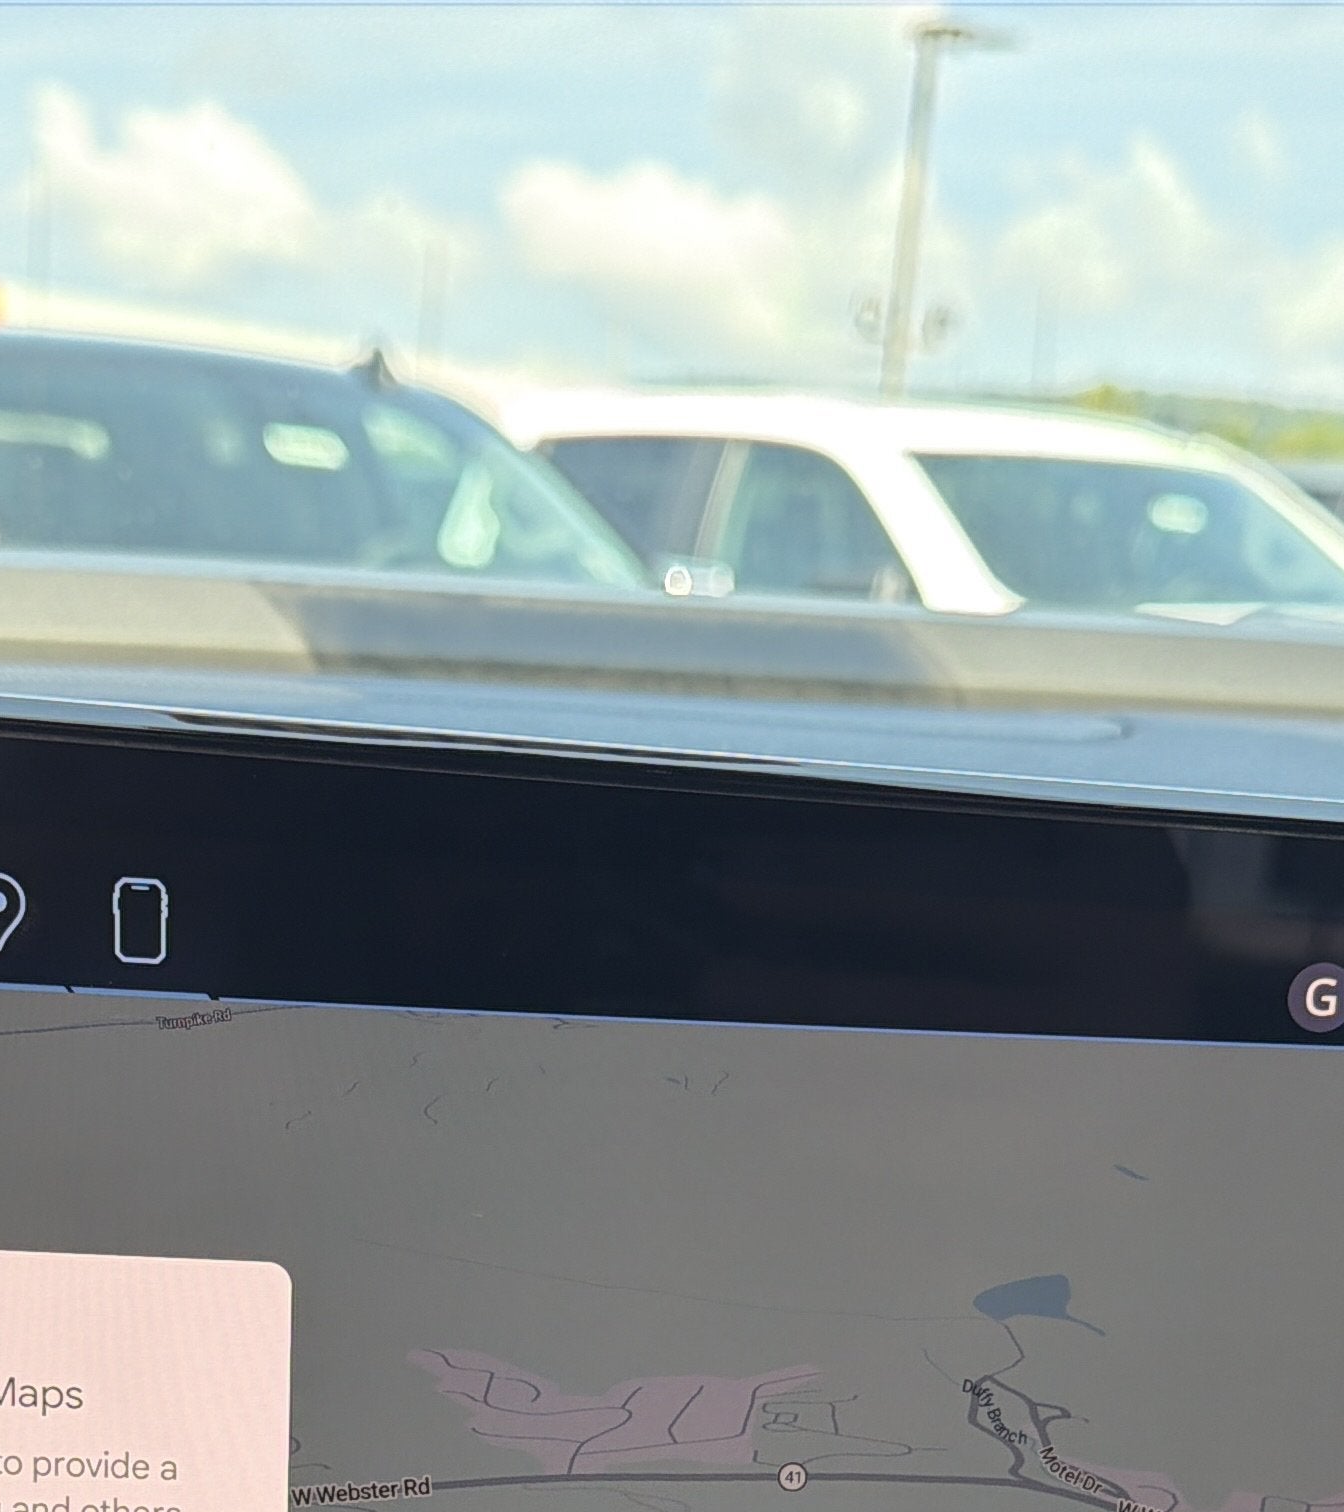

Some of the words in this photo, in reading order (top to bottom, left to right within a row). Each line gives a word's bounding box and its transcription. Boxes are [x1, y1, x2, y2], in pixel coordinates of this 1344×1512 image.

[1306, 979, 1336, 1016] G
[156, 1014, 212, 1031] Turnpike
[213, 1009, 232, 1024] Rd
[962, 1379, 994, 1407] Duffy
[987, 1408, 1027, 1444] Branch
[34, 1451, 149, 1483] provide
[161, 1461, 176, 1480] a
[784, 1469, 802, 1485] 41
[1039, 1446, 1081, 1486] Motel
[1082, 1475, 1102, 1494] Dr
[291, 1487, 312, 1506] W
[316, 1482, 399, 1504] Webster
[404, 1477, 430, 1496] Rd
